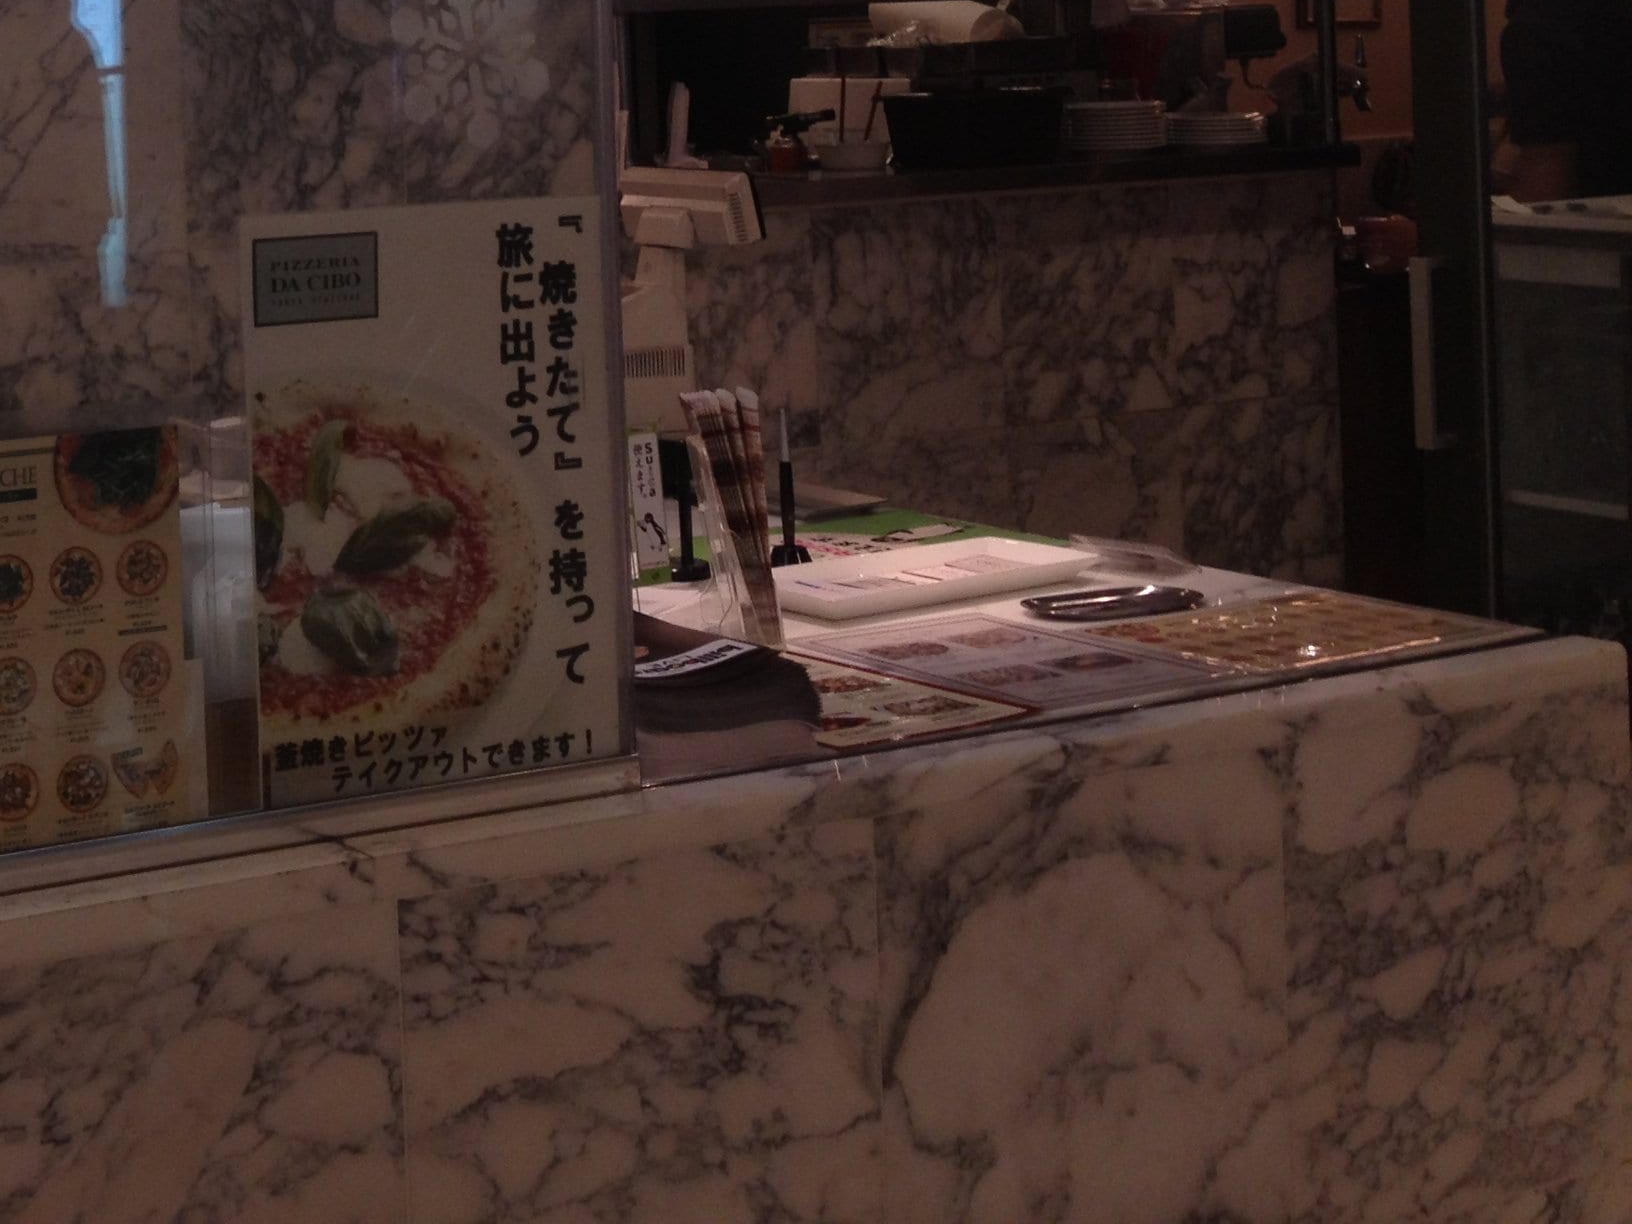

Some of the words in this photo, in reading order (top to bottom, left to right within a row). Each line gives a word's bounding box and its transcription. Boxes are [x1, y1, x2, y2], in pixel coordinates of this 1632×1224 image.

[270, 255, 361, 272] PIZZERIA
[271, 277, 300, 294] DA
[307, 271, 361, 292] CIBO
[495, 222, 541, 457] 旅に出よう
